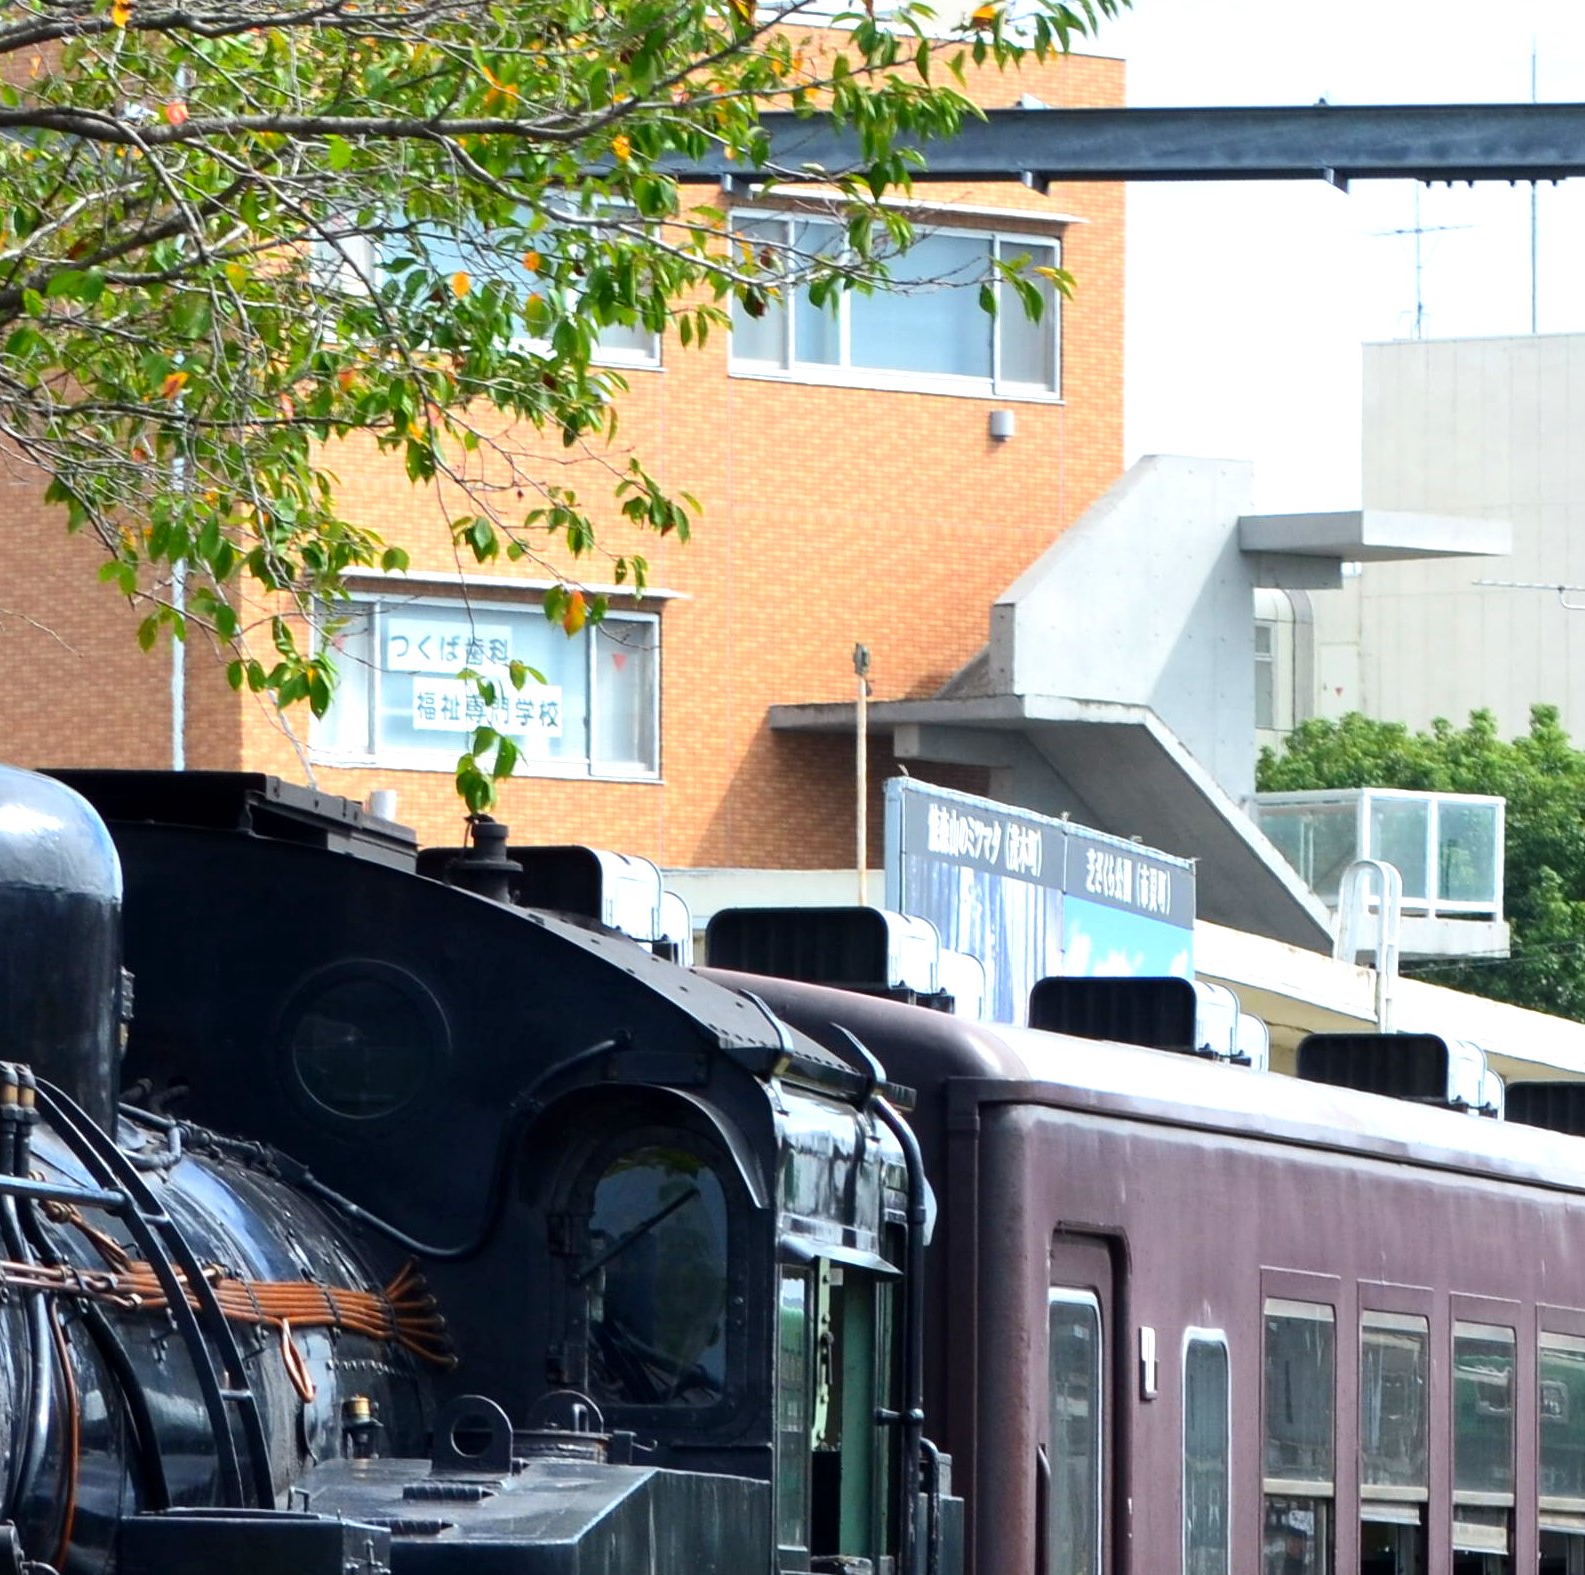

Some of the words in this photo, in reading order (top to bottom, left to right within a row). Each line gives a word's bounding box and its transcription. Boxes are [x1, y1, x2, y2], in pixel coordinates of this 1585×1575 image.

[389, 633, 509, 667] つくば歯科
[416, 691, 561, 729] 福祉専門学校
